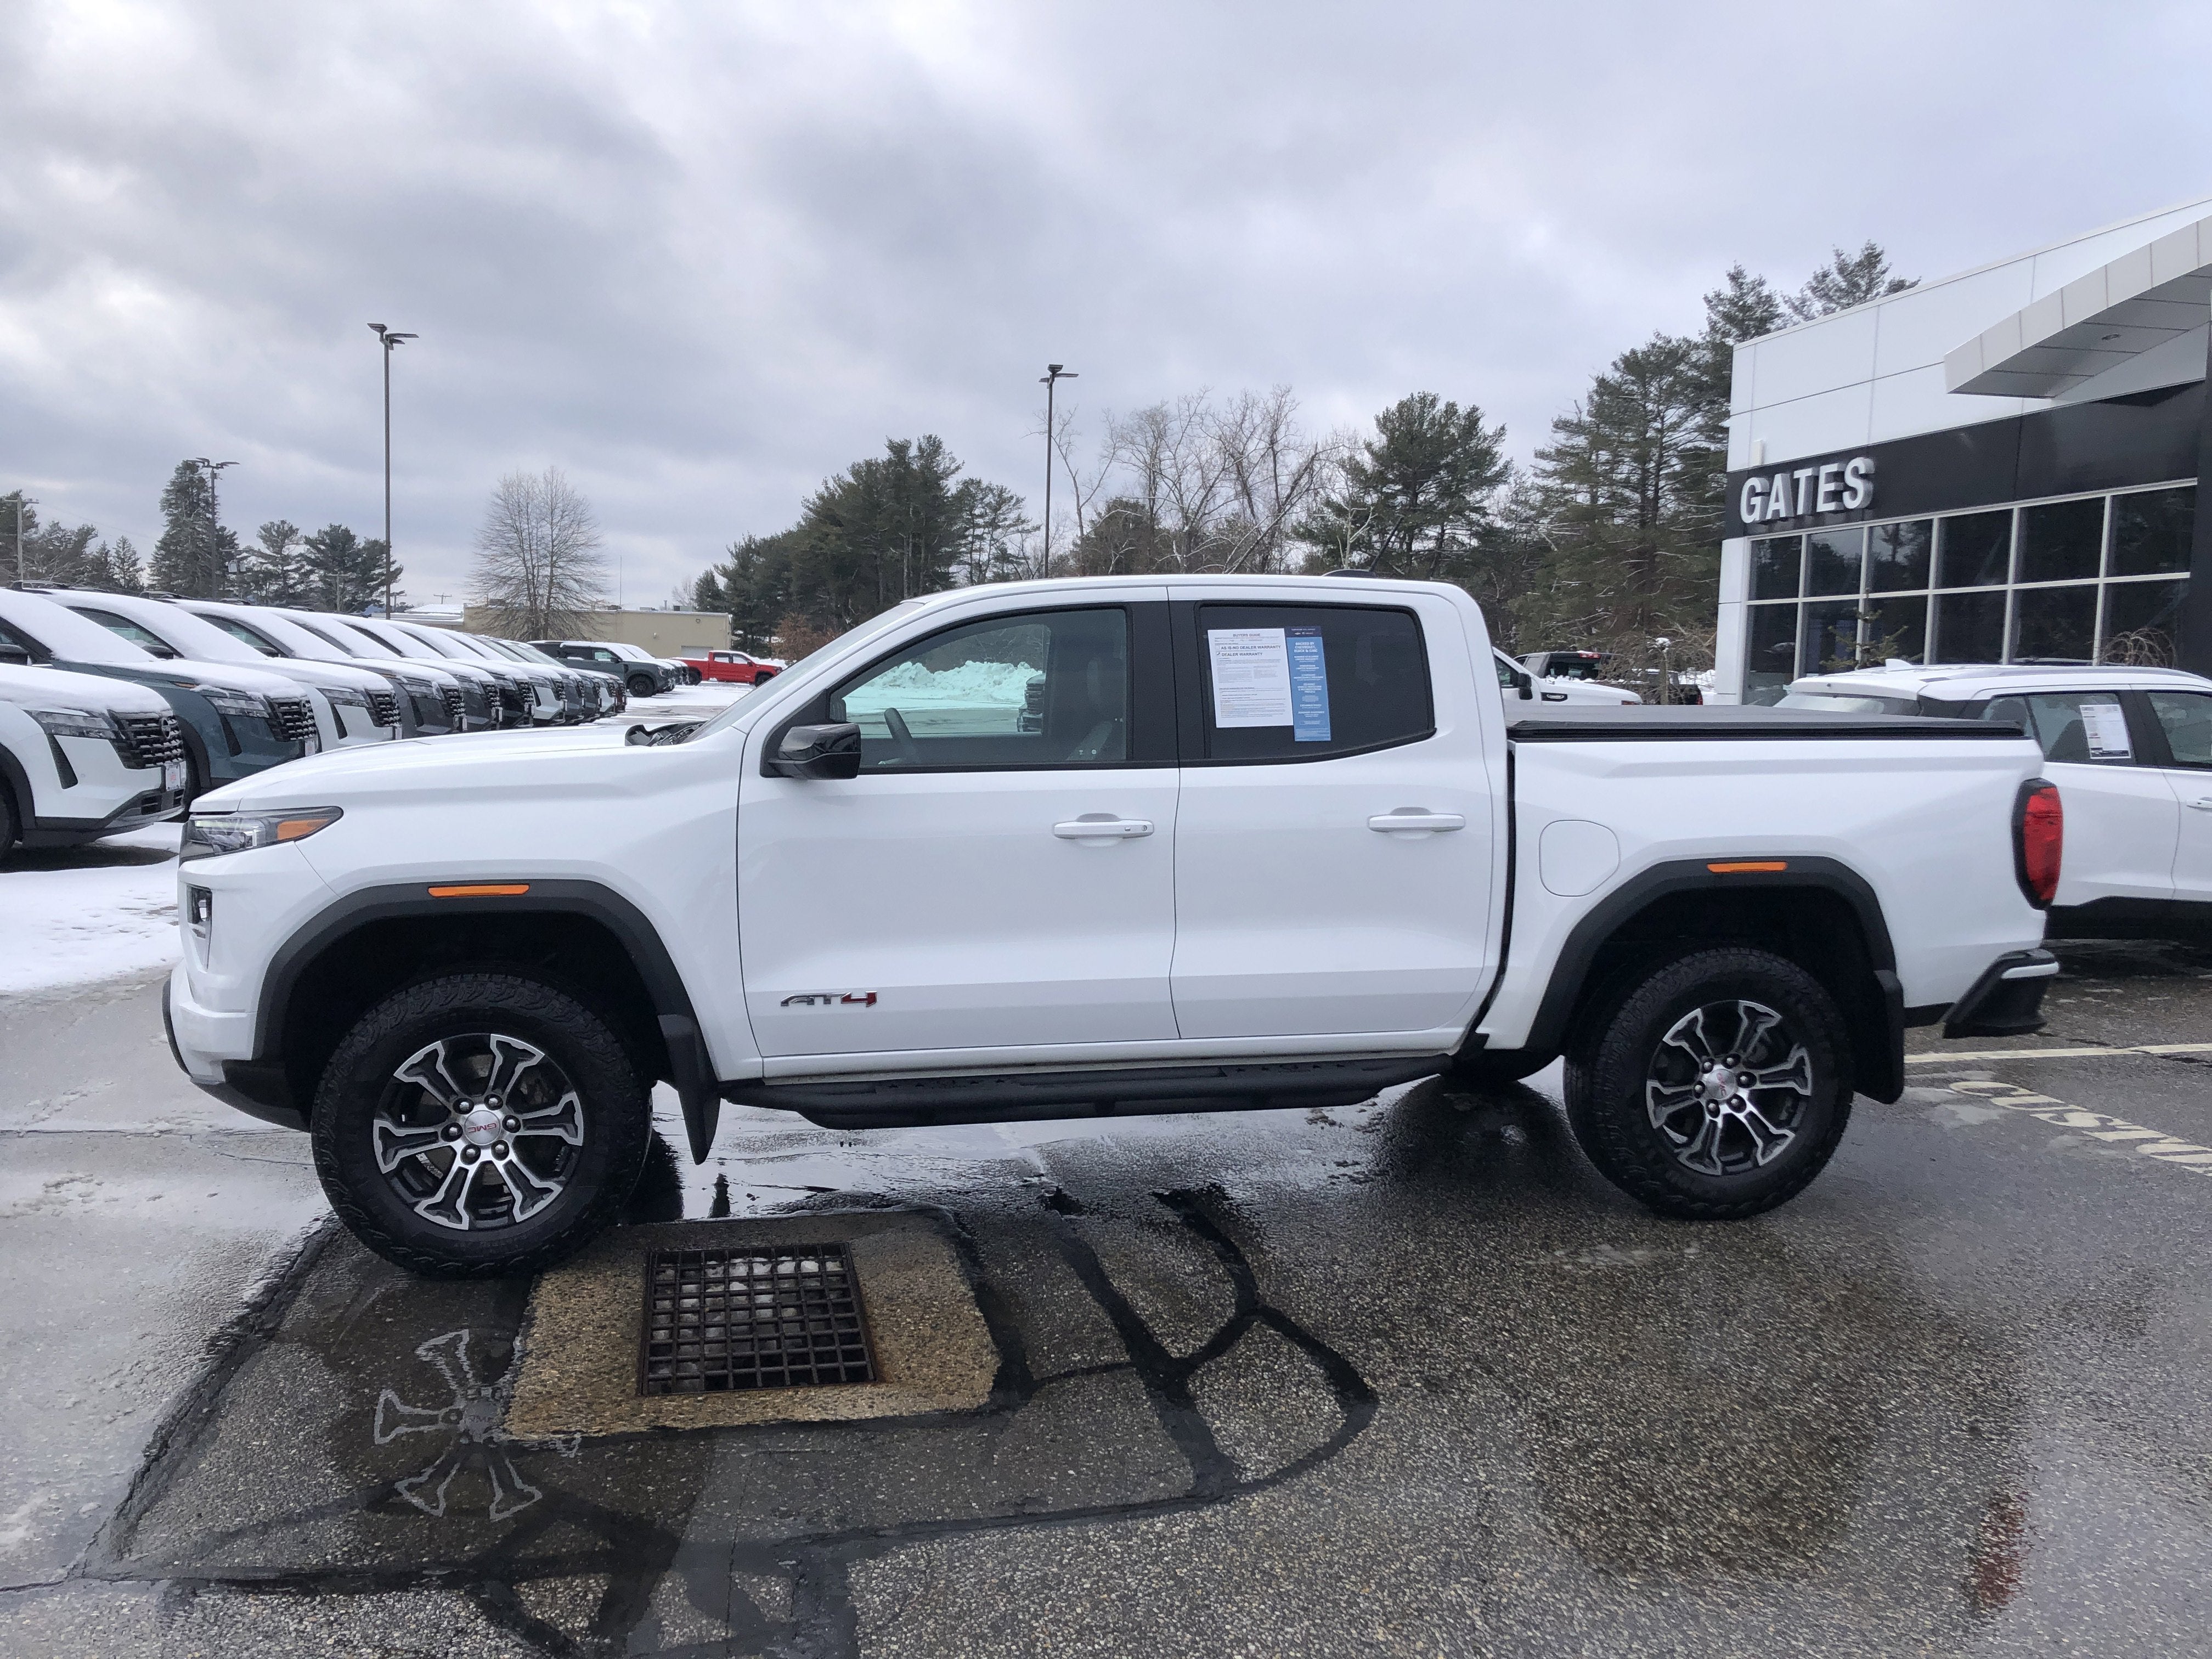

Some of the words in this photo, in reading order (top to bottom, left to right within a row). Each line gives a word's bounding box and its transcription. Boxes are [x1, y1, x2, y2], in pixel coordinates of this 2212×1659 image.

[1740, 457, 1875, 523] GATES
[781, 991, 877, 1007] AT4
[467, 1122, 497, 1133] GMC
